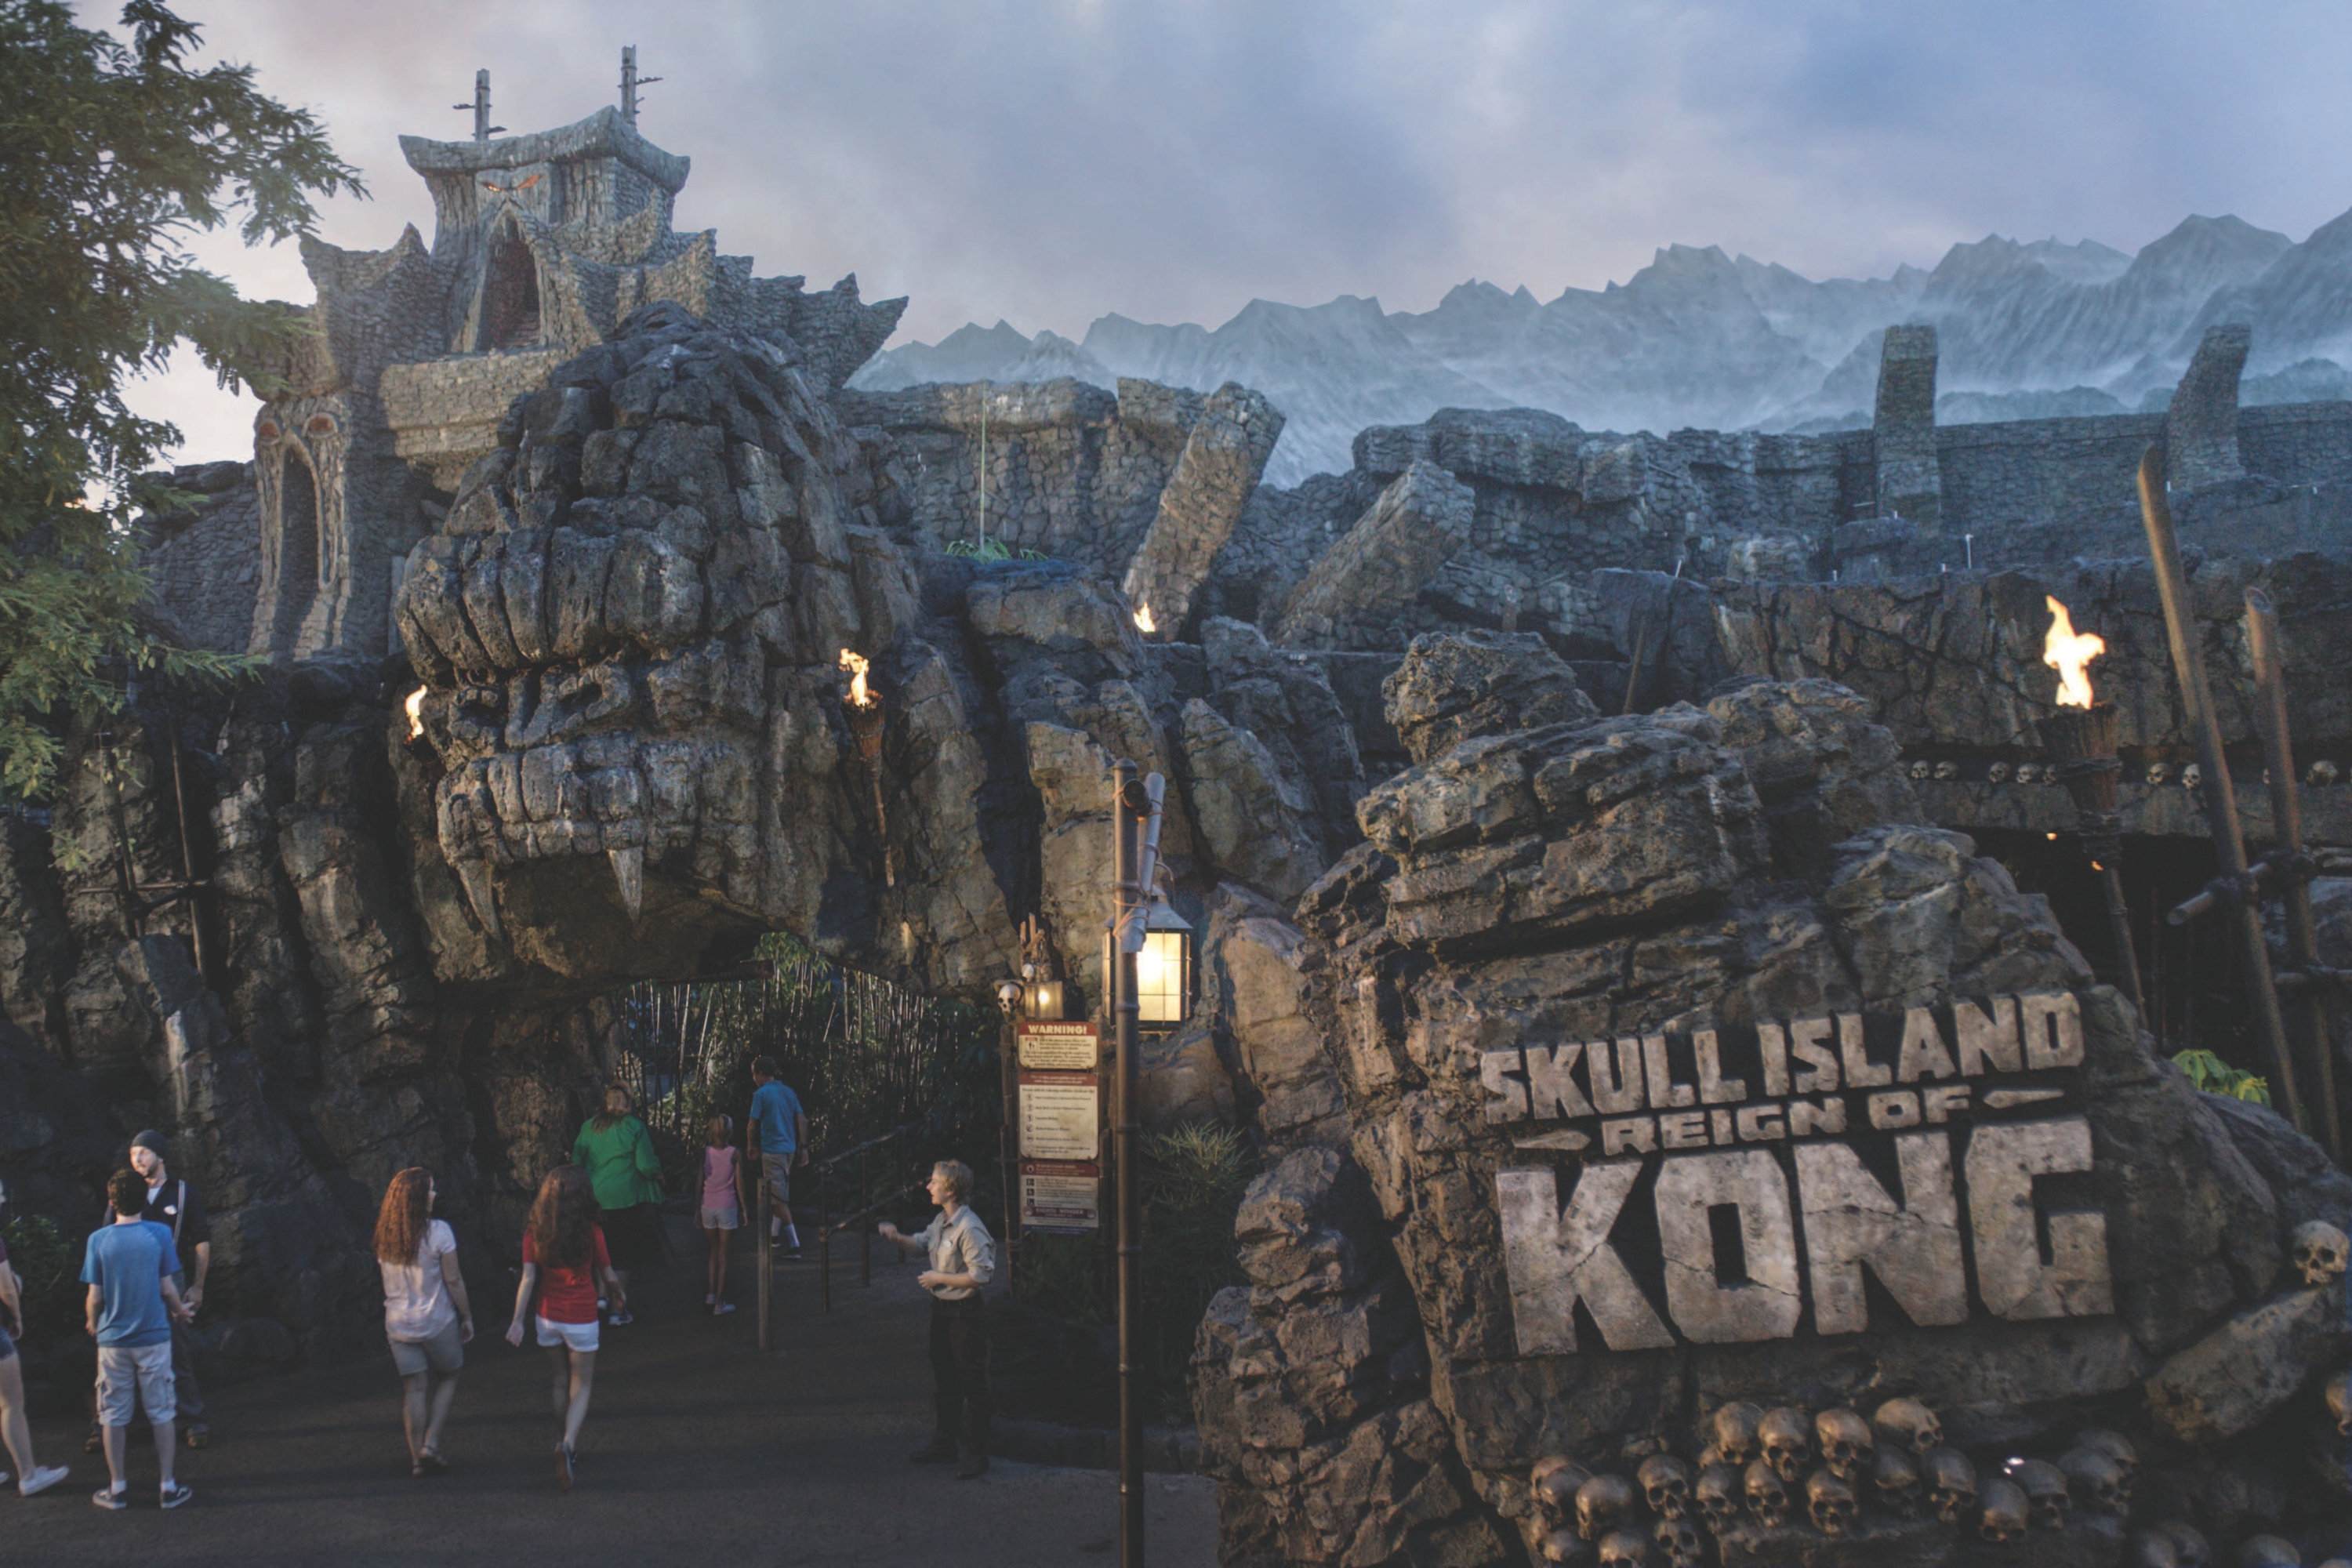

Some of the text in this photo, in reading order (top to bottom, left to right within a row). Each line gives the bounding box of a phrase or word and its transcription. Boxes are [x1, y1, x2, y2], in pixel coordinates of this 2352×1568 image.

[1028, 1025, 1087, 1034] WARNING!
[1480, 991, 2085, 1124] SKULL ISLAND
[1602, 1084, 1972, 1156] REIGN OF
[1494, 1115, 2115, 1356] KONG
